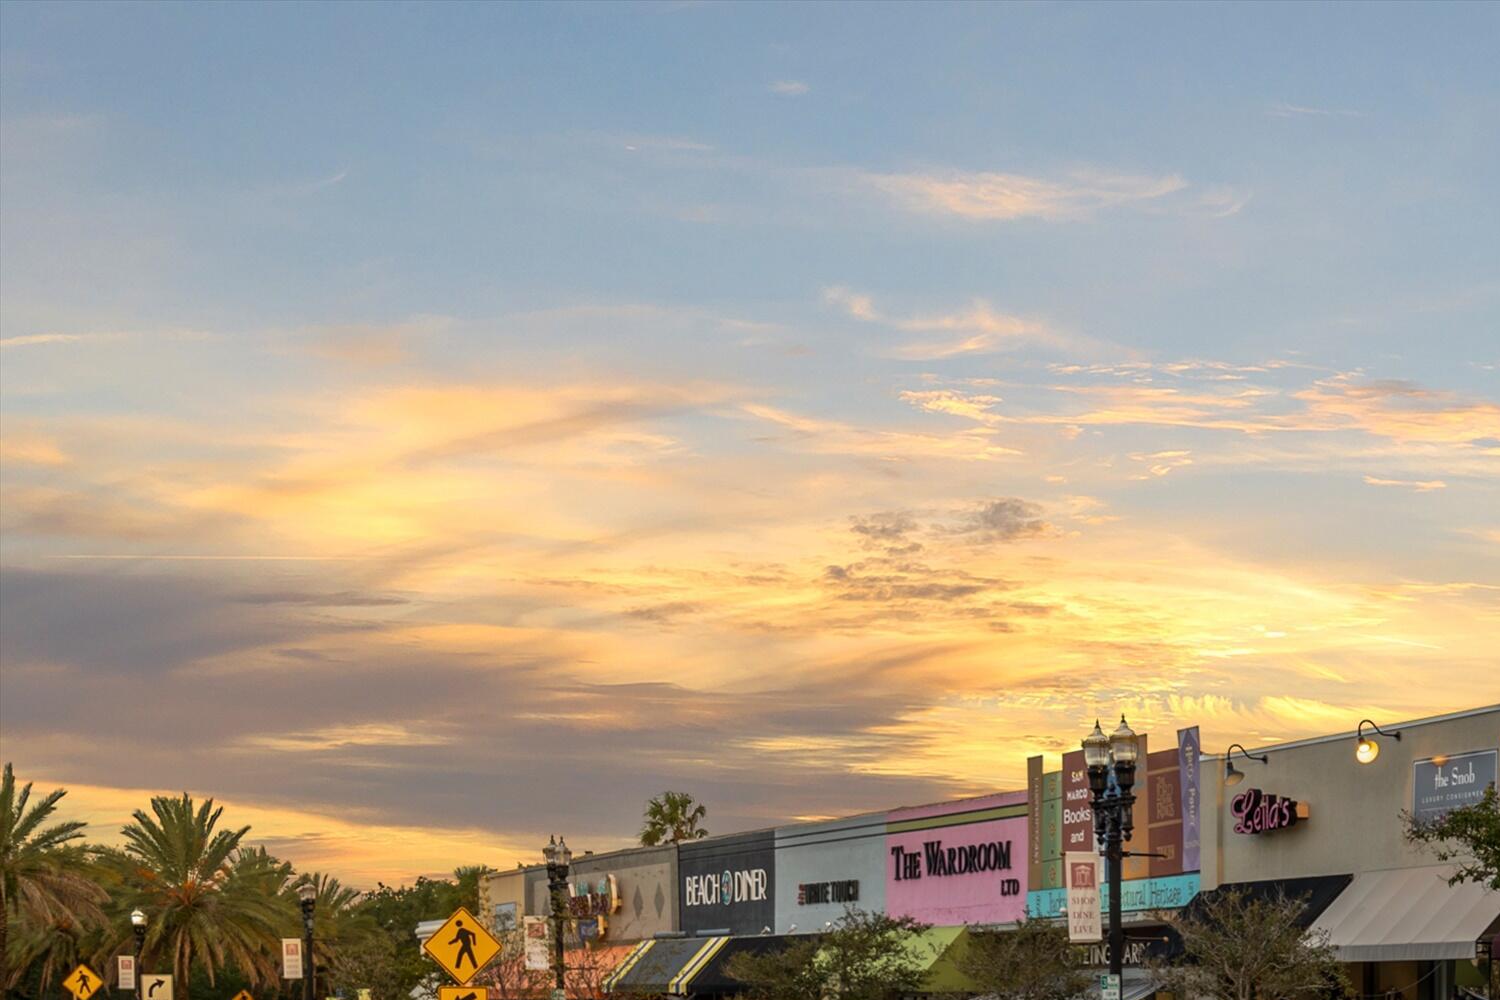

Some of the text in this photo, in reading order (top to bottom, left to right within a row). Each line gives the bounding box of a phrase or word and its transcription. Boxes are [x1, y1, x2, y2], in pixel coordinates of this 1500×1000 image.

[1434, 761, 1475, 790] the Snob
[1066, 787, 1088, 801] MARCO
[1063, 806, 1091, 825] Books
[1070, 830, 1085, 843] and
[685, 871, 720, 906] BEACH
[734, 868, 768, 902] DINER
[1000, 878, 1020, 897] LTD
[1071, 896, 1096, 906] SHOP
[1072, 911, 1095, 920] DINE
[1073, 925, 1094, 934] LIVE
